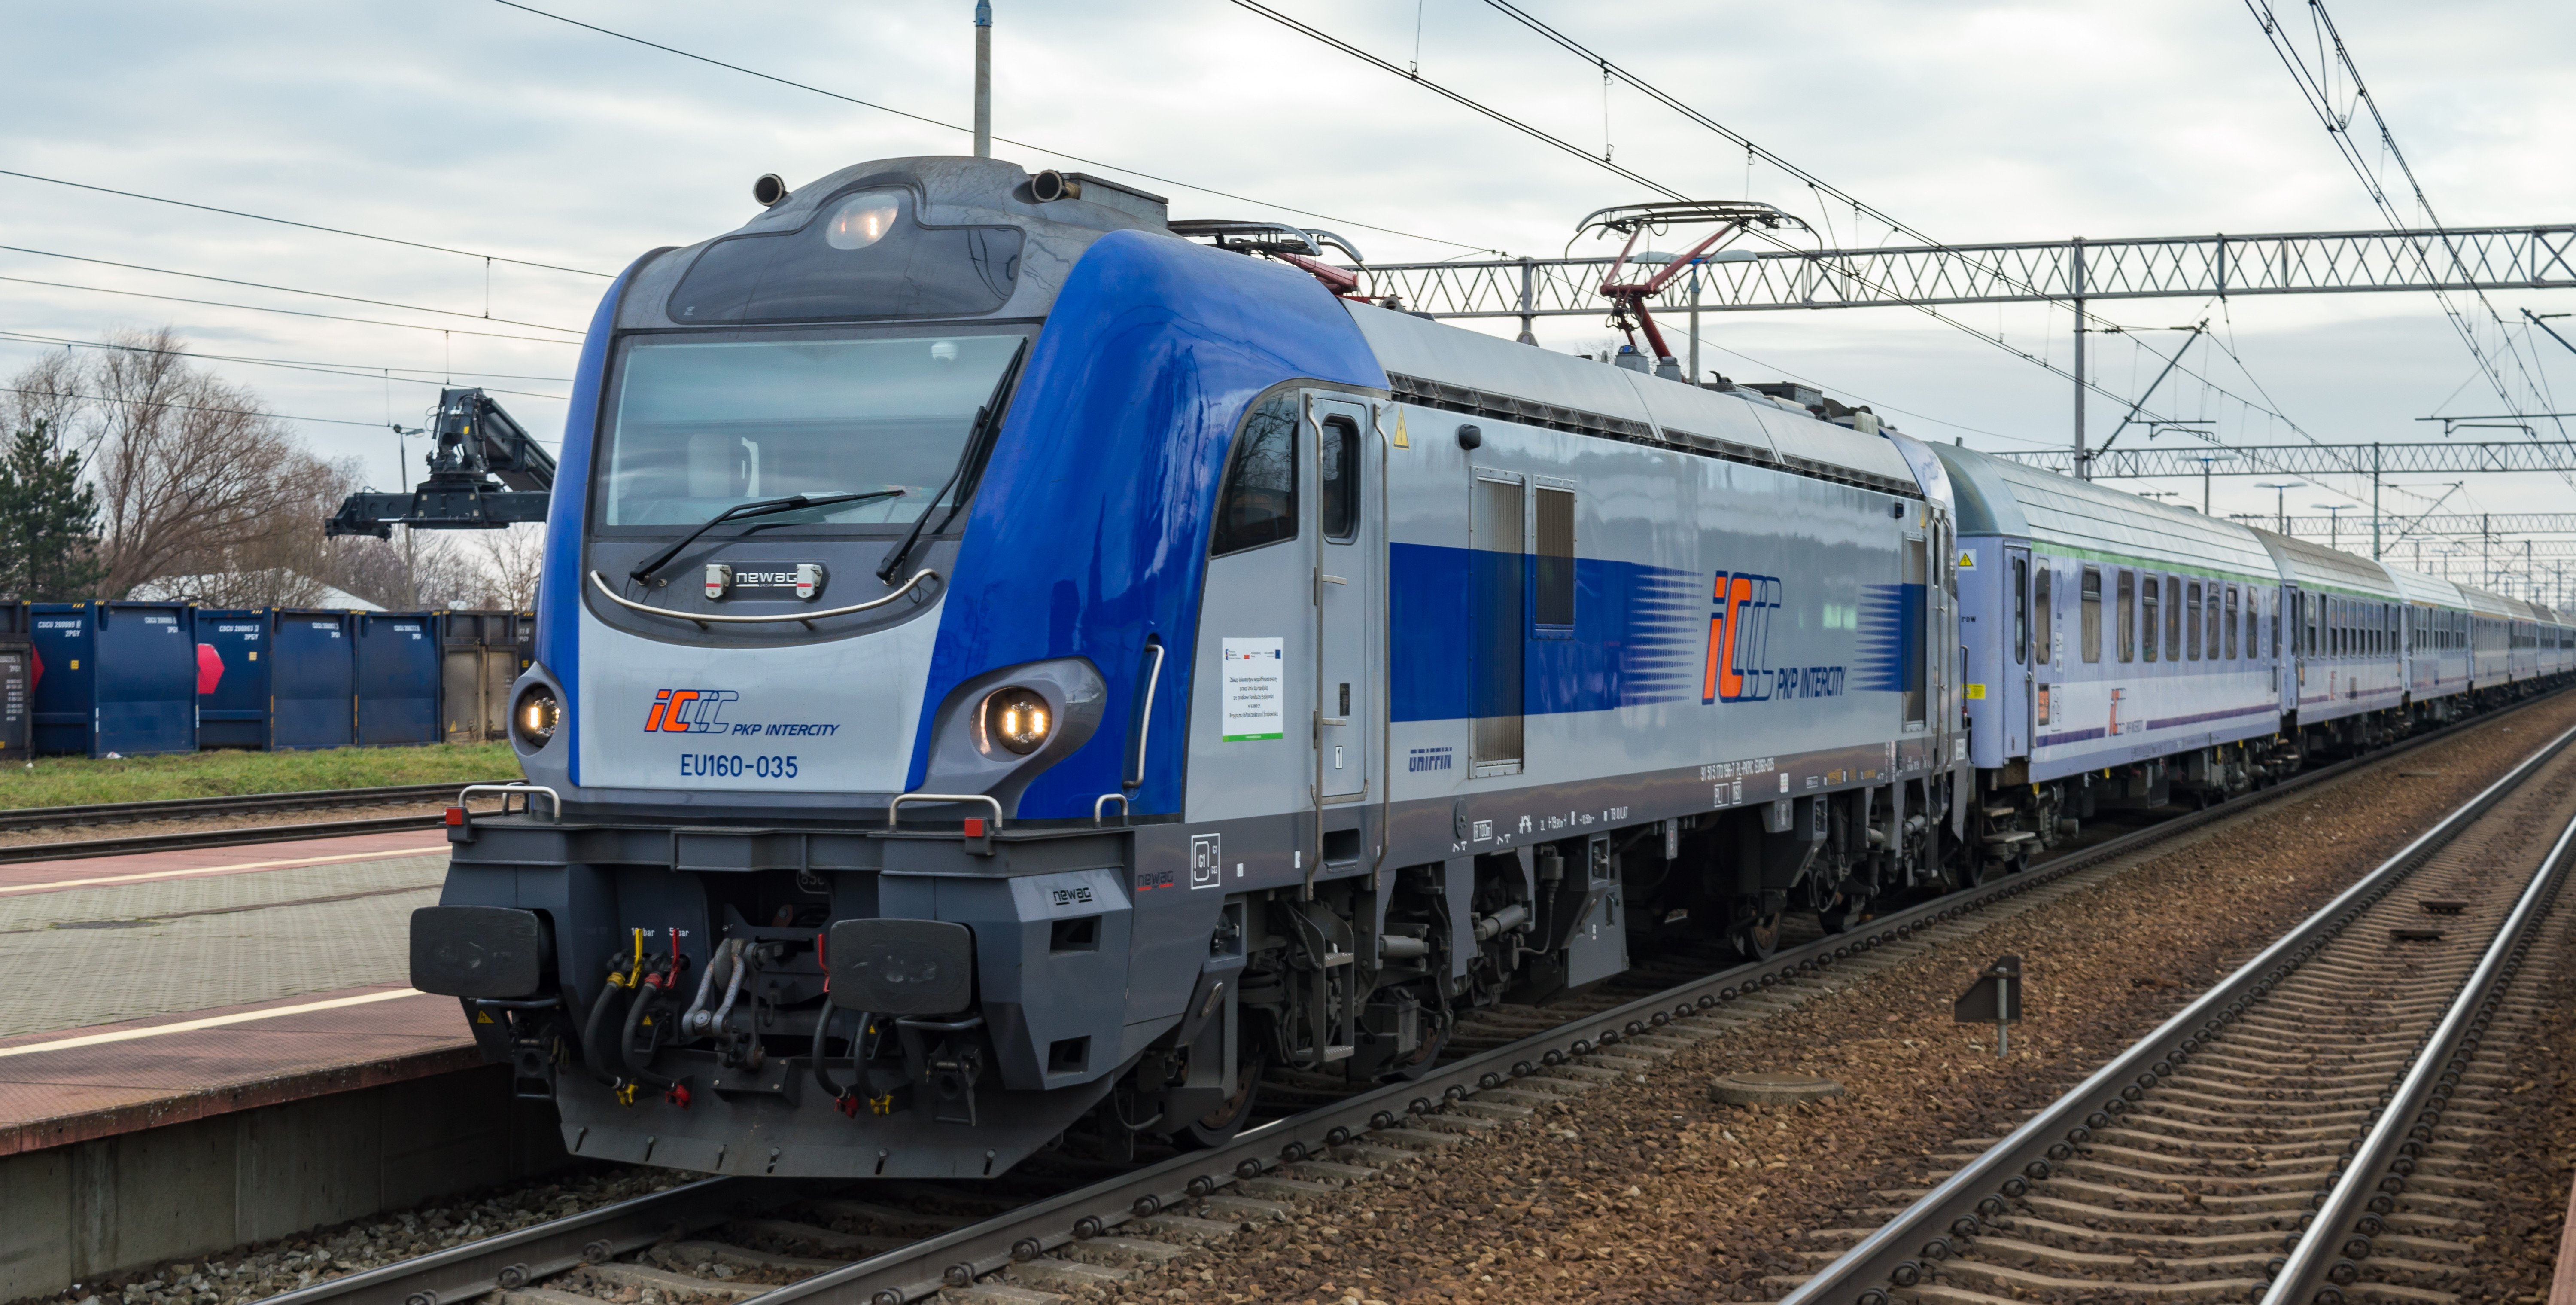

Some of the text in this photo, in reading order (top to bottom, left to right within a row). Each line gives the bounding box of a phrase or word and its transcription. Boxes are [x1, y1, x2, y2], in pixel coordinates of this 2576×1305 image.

[1776, 666, 1846, 700] PKP INTERCITY
[732, 724, 841, 736] PKP INTERCITY
[681, 754, 798, 778] EU160-035
[1409, 747, 1452, 772] GRIFFIN
[1475, 823, 1491, 838] R 100m
[643, 927, 655, 936] bar
